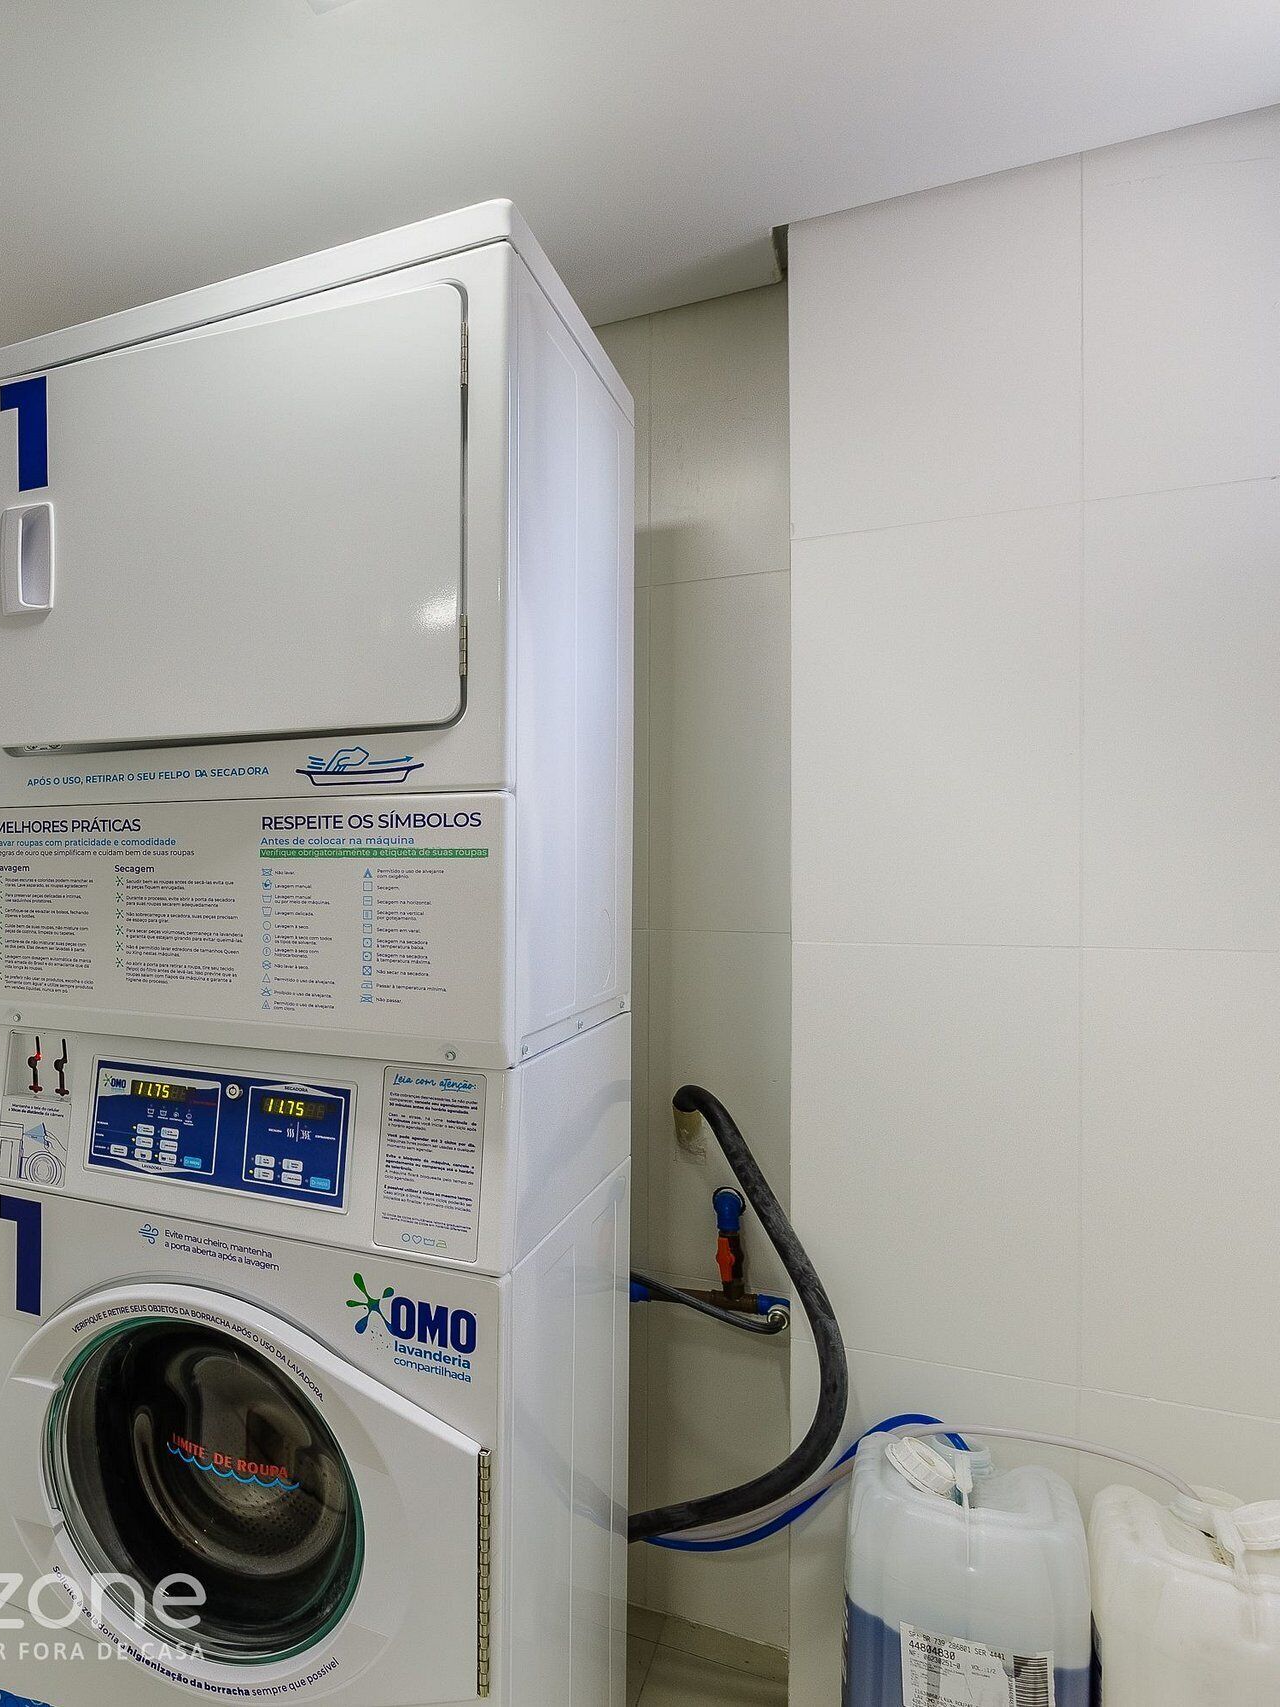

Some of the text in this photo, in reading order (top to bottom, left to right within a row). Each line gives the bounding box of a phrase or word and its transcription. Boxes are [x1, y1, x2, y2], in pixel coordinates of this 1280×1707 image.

[0, 376, 49, 492] 1
[27, 766, 269, 786] APÓS O USO, RETIRAR O SEU FELPO DA SECADORA
[71, 816, 140, 832] PRÁTICAS
[261, 810, 481, 830] RESPEITE OS SÍMBOLOS
[114, 864, 154, 874] Secagem
[110, 1078, 127, 1089] OMO
[393, 1073, 477, 1092] Leia com atenção:
[0, 1194, 42, 1316] 1
[164, 1229, 272, 1258] Evite mau cheiro, mantenha
[170, 1242, 190, 1252] porta
[191, 1245, 216, 1257] aberta
[217, 1252, 237, 1262] após
[244, 1255, 279, 1271] lavagem
[72, 1312, 103, 1334] VERIFIQUE
[107, 1306, 130, 1318] RETIRE
[130, 1304, 147, 1313] SEUS
[147, 1304, 179, 1314] OBJETOS
[179, 1307, 191, 1316] DA
[190, 1310, 231, 1329] BORRACHA
[231, 1324, 252, 1339] APÓS
[252, 1334, 259, 1343] O
[259, 1338, 275, 1353] USO
[275, 1349, 287, 1363] DA
[388, 1296, 476, 1353] OMO
[394, 1340, 470, 1369] lavanderia
[393, 1357, 471, 1383] compartilhada
[172, 1433, 288, 1478] LIMITE DE ROUPA
[190, 1657, 340, 1696] da borracha sempre que possível
